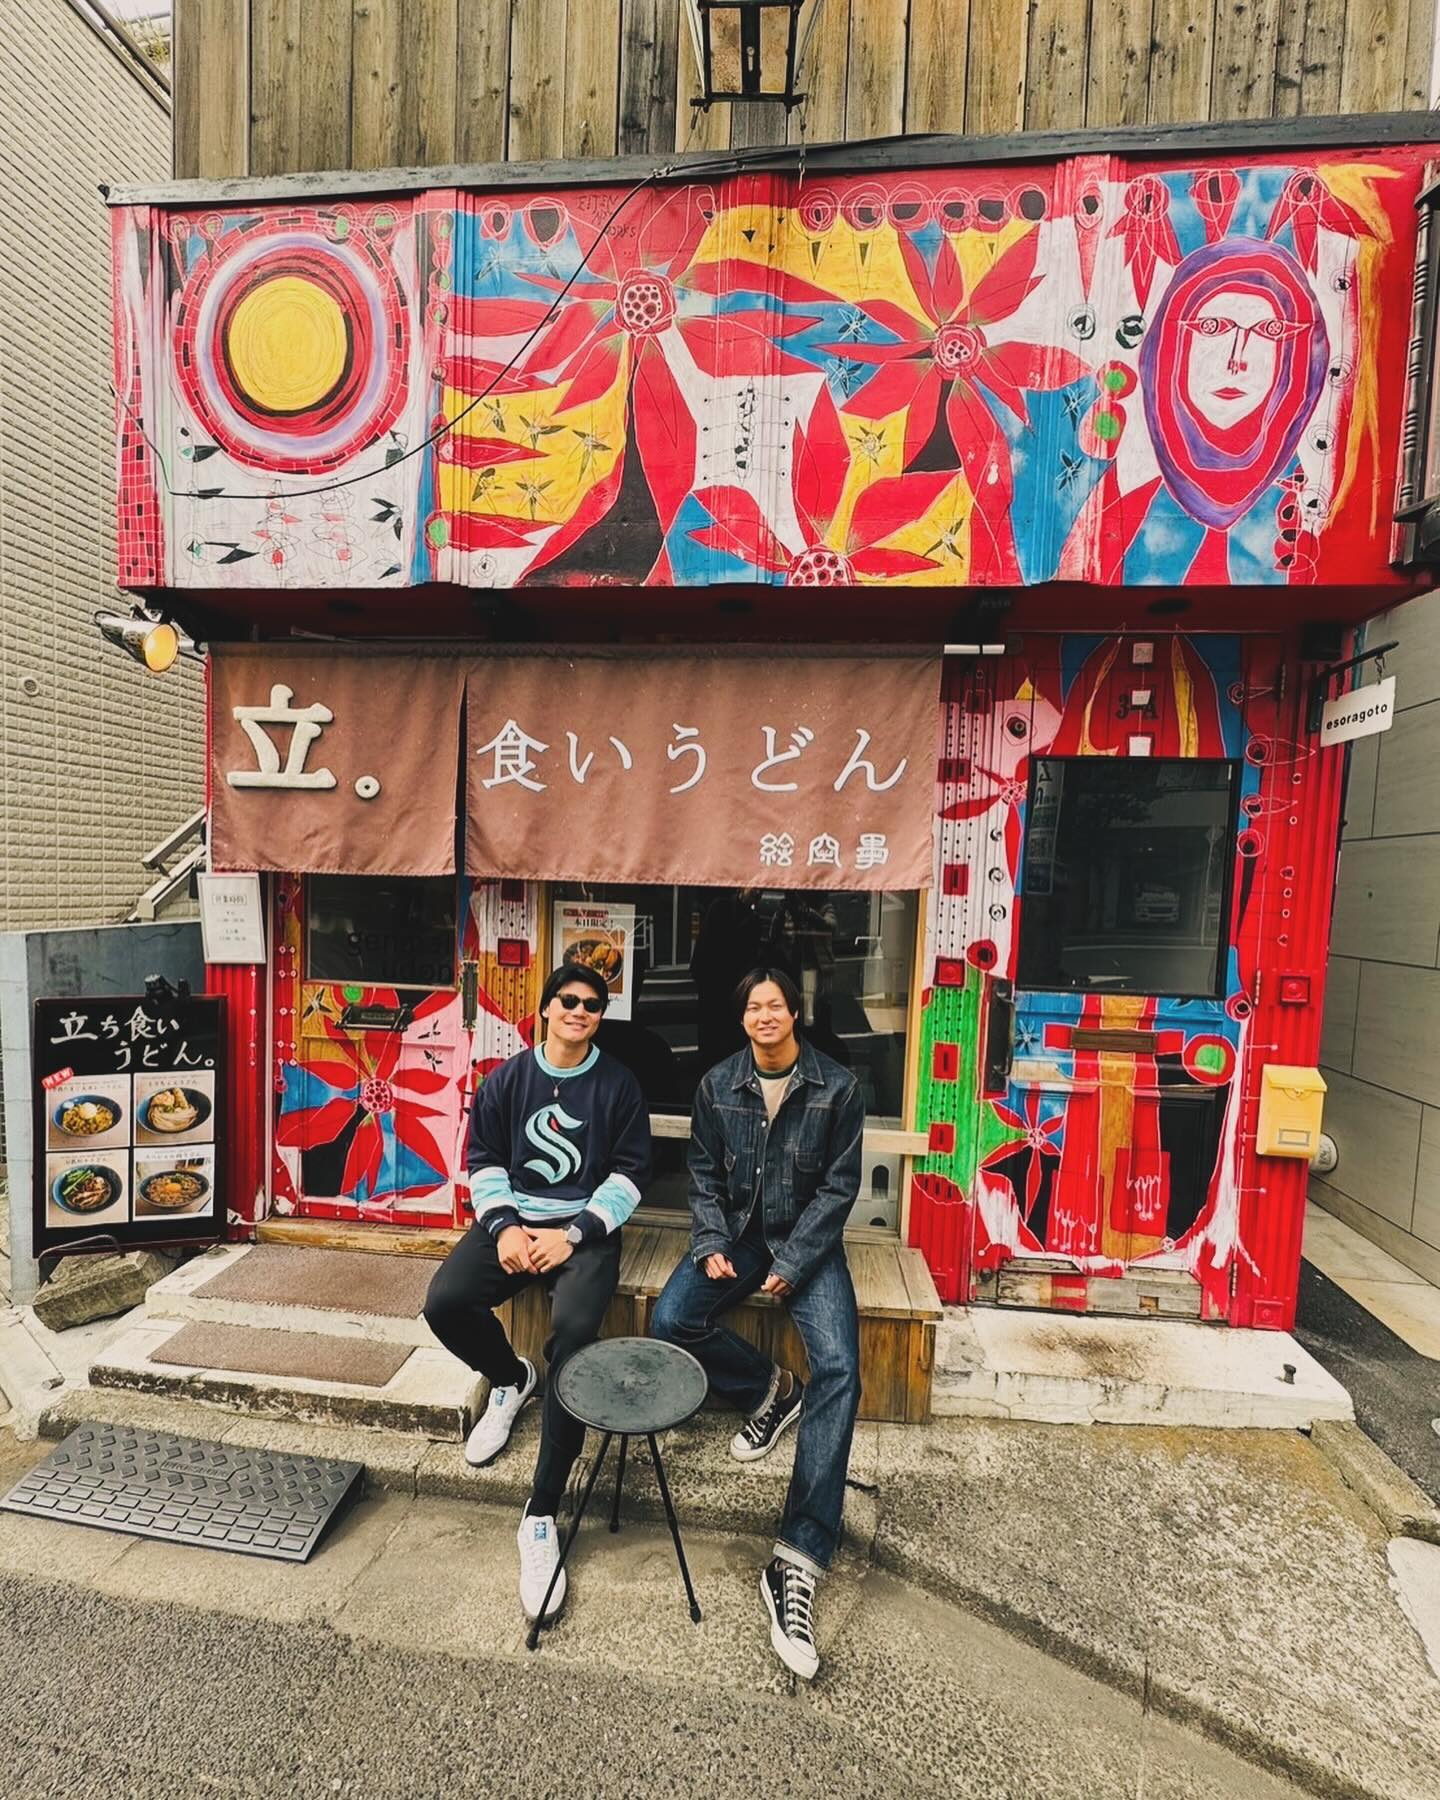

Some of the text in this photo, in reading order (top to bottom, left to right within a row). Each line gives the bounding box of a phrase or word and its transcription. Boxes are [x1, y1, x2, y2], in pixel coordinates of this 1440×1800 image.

[1326, 703, 1388, 730] esoragoto
[477, 718, 907, 794] 食いうどん
[50, 1005, 180, 1044] 立ち食い
[114, 1040, 215, 1070] うどん。
